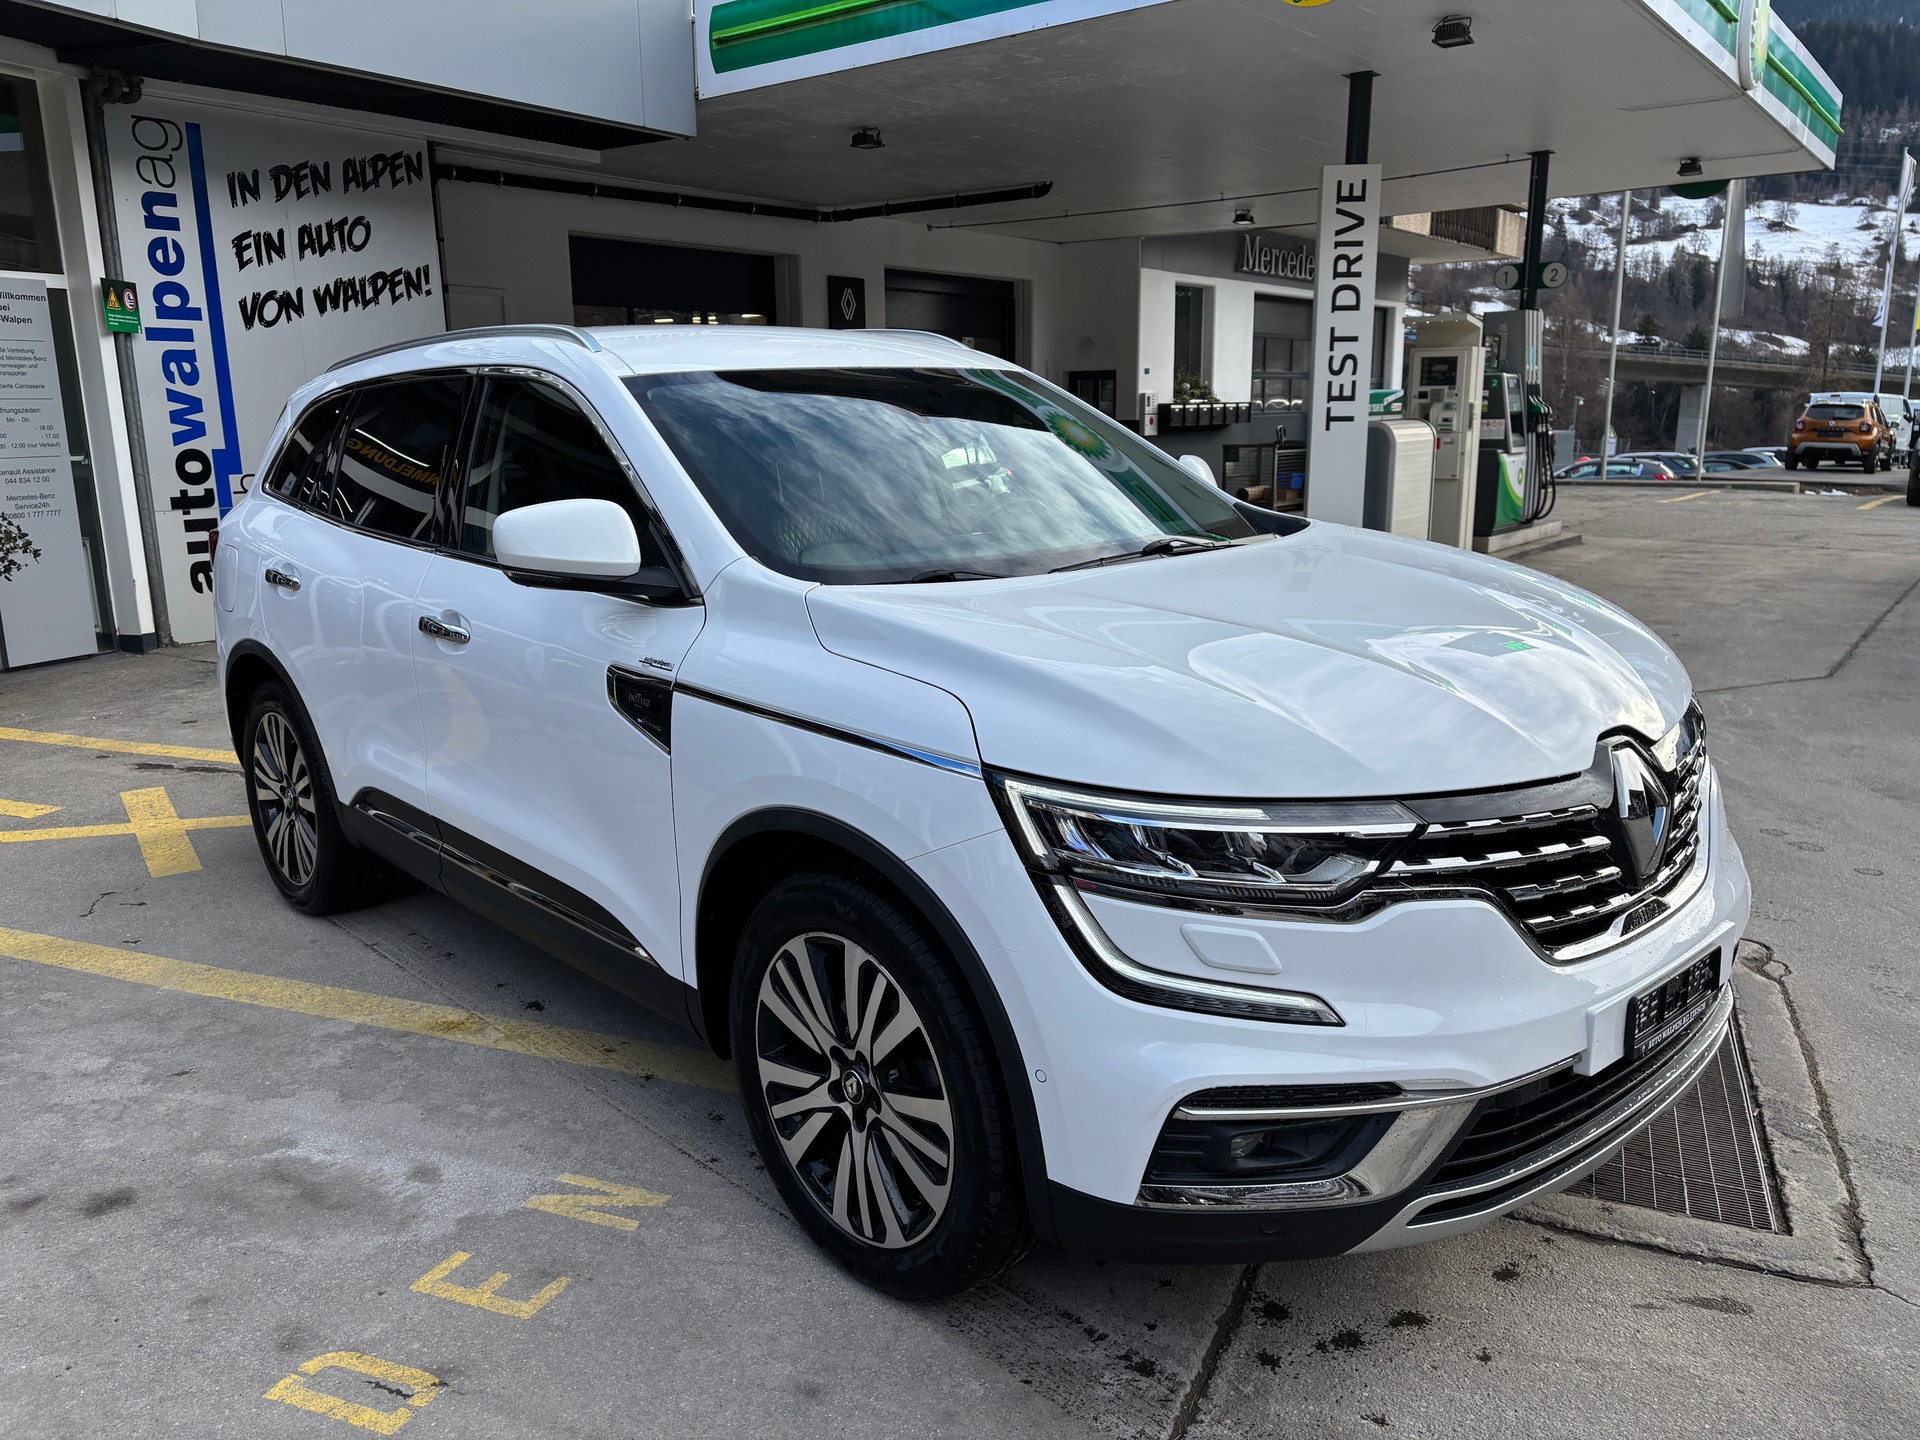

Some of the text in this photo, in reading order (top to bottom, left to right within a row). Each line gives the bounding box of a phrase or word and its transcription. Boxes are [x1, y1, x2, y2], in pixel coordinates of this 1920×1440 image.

[226, 151, 424, 208] IN DEN ALPEN
[231, 216, 371, 272] EIN AUTO
[1242, 233, 1315, 280] Mercede
[238, 264, 432, 332] VON WALPEN!
[1503, 271, 1508, 284] 1
[1550, 268, 1558, 281] 2
[0, 315, 33, 325] Walpen
[1326, 179, 1367, 431] TEST DRIVE
[6, 493, 55, 501] Mercedes-Benz
